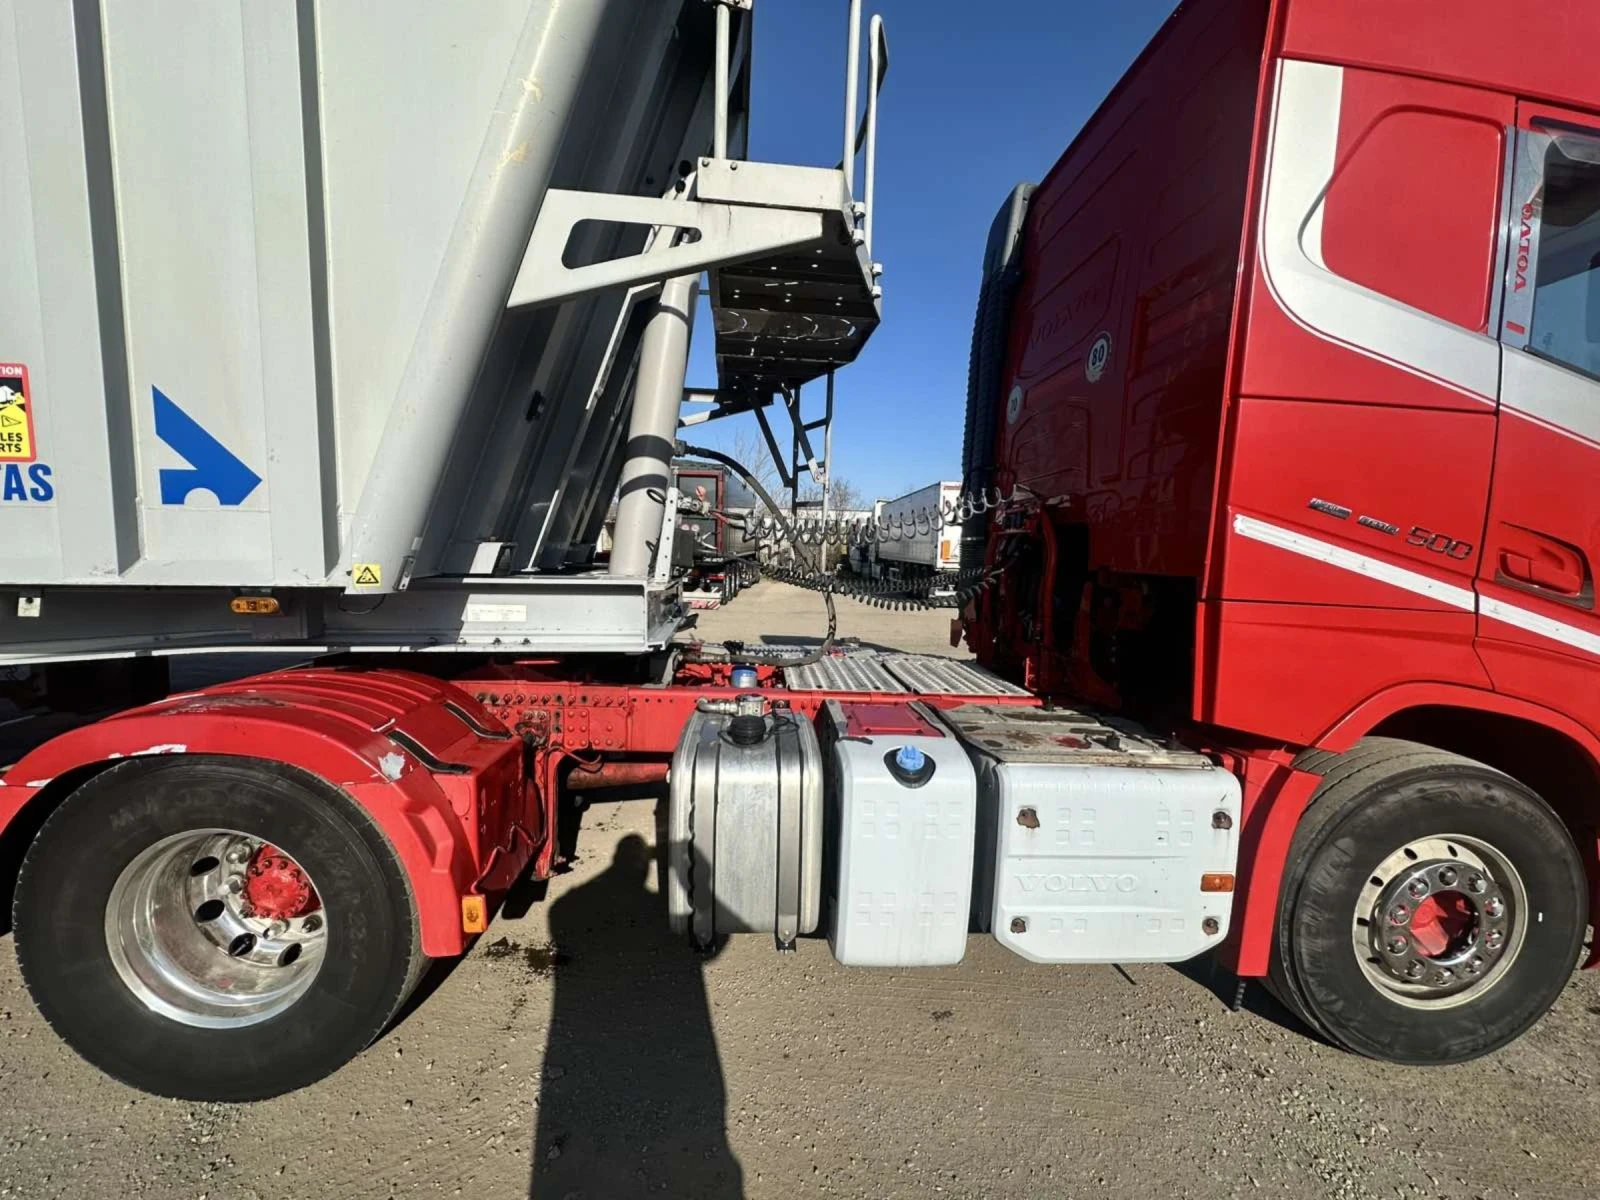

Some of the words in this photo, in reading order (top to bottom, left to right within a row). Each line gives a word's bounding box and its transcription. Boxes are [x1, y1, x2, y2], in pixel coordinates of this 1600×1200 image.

[1513, 202, 1534, 293] VOLVO
[1091, 343, 1105, 367] 80
[0, 366, 23, 376] ION
[0, 432, 23, 443] LES
[0, 463, 54, 502] AS
[1405, 525, 1474, 561] 500
[1013, 873, 1139, 894] VOLVO
